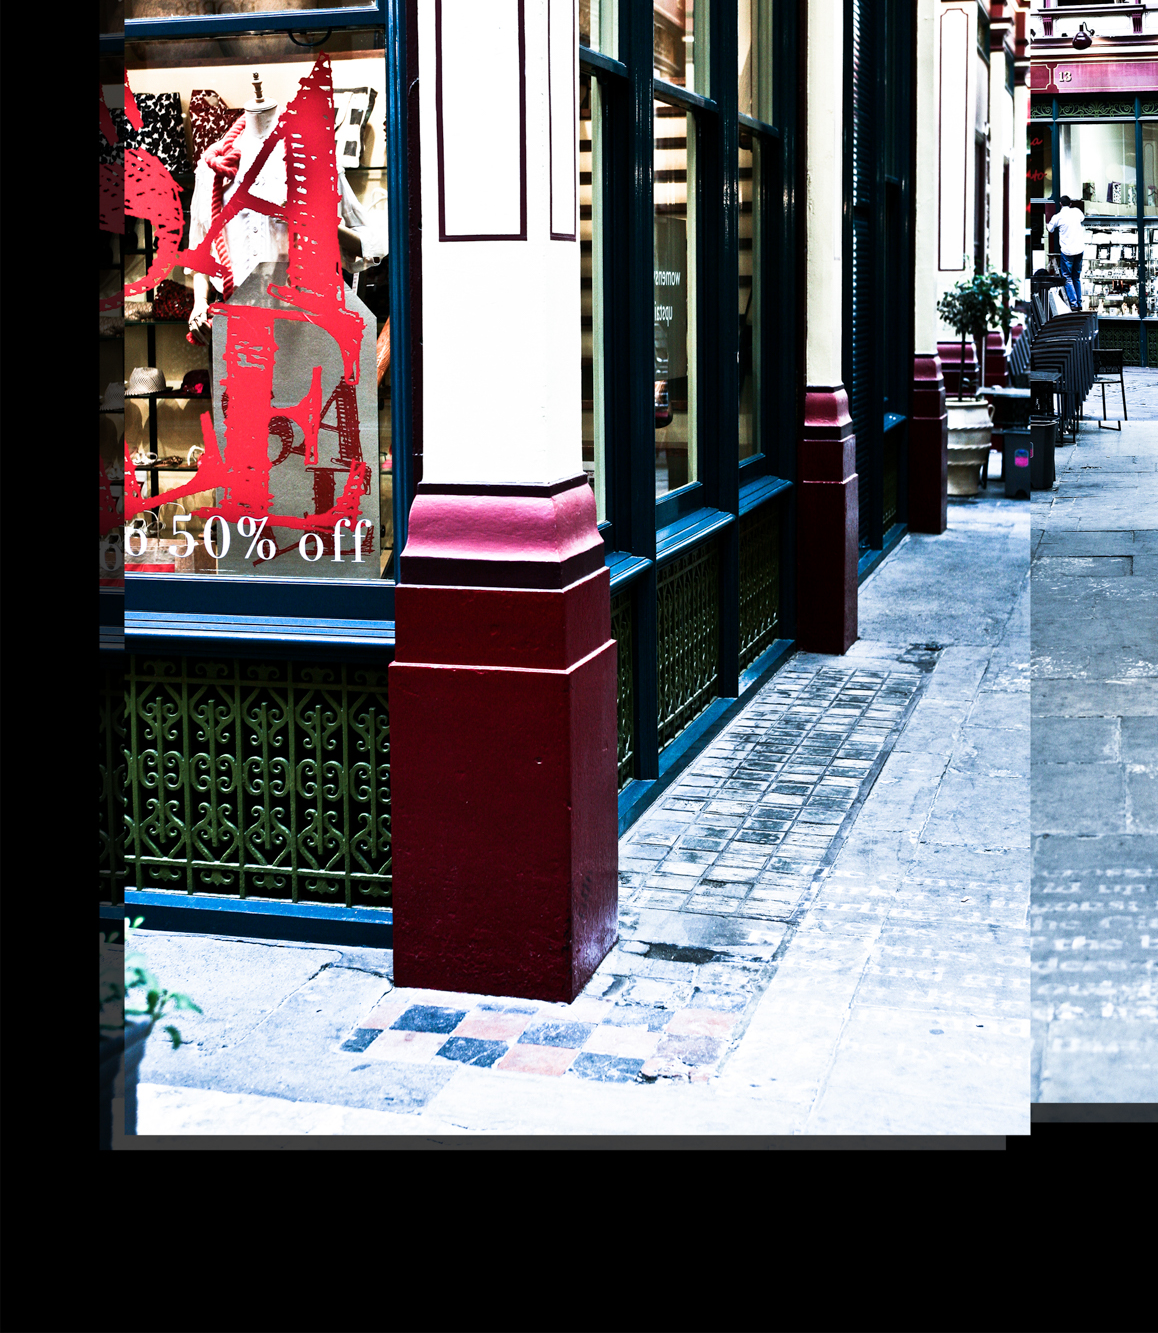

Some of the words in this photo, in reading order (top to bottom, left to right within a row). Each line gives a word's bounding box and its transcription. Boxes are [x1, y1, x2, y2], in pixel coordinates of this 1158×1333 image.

[1058, 71, 1072, 83] 13
[168, 513, 277, 561] 50%
[298, 518, 373, 563] off
[1053, 935, 1124, 952] the
